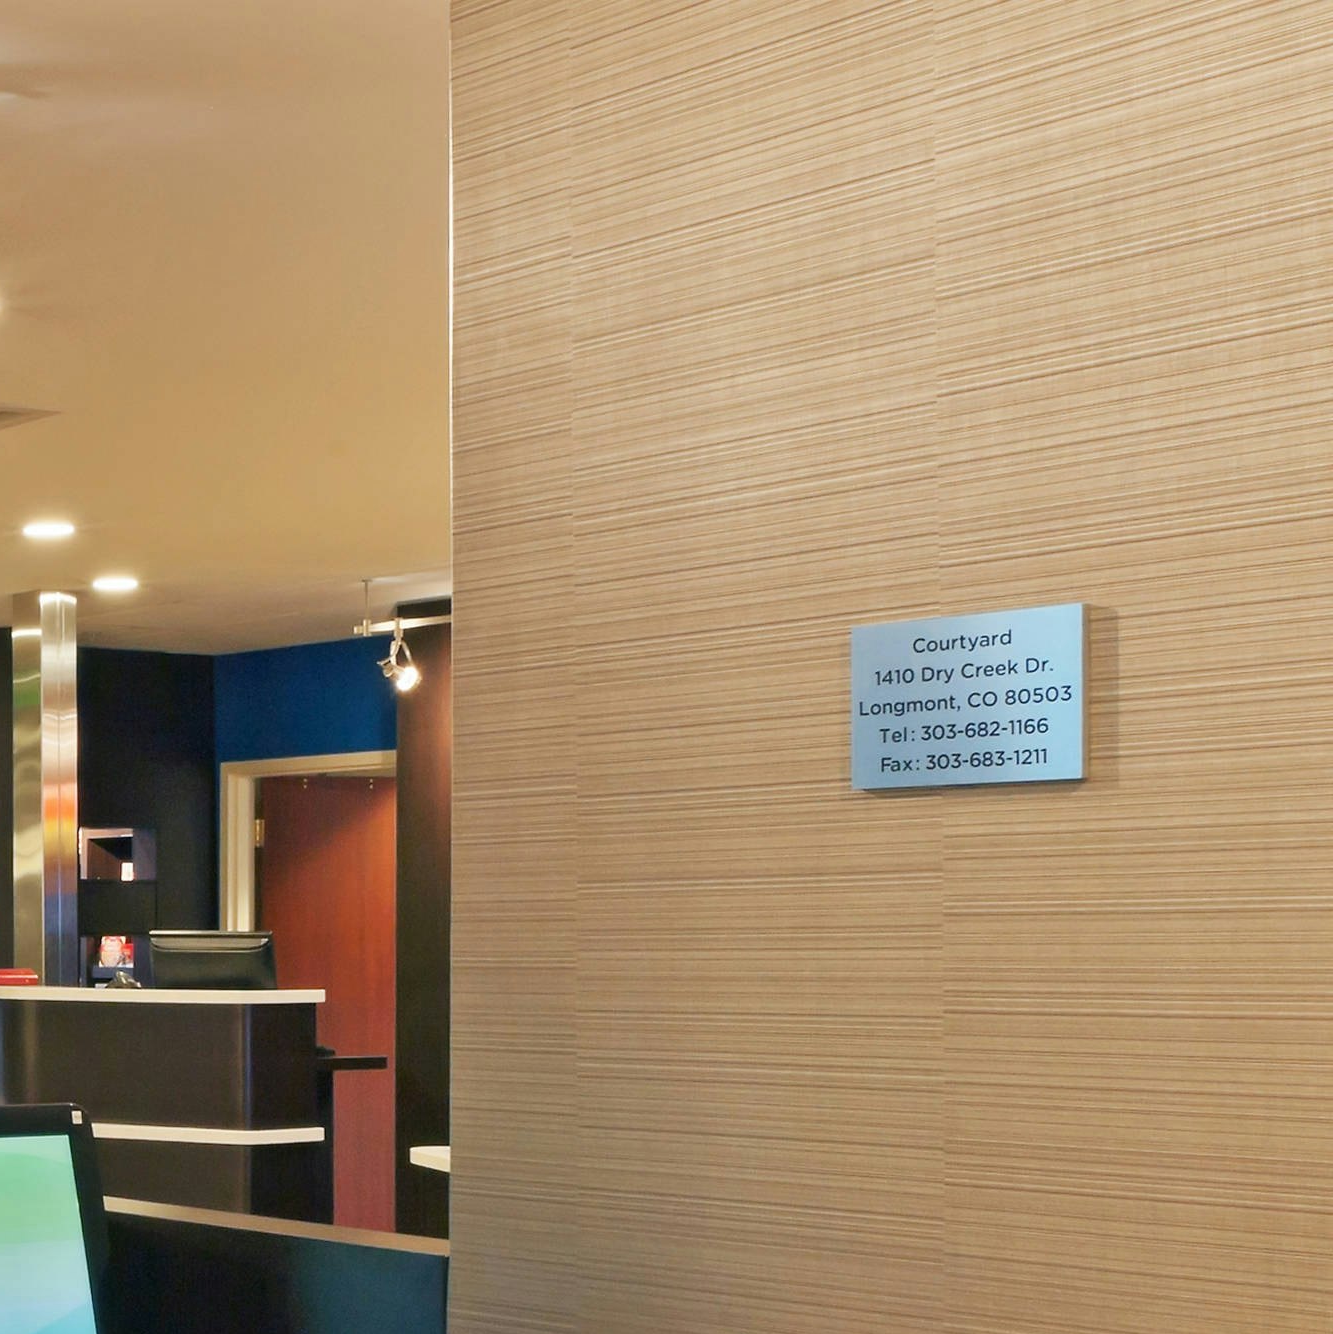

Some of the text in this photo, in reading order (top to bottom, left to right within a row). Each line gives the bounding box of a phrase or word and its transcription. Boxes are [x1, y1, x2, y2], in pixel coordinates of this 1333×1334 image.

[913, 629, 1012, 653] Courtyard
[875, 658, 1054, 686] 1410 Dry Creek Dr.
[859, 685, 1072, 717] Longmont, CO 80503
[921, 718, 1049, 741] 303-682-1166
[926, 748, 1047, 771] 303-683-1211
